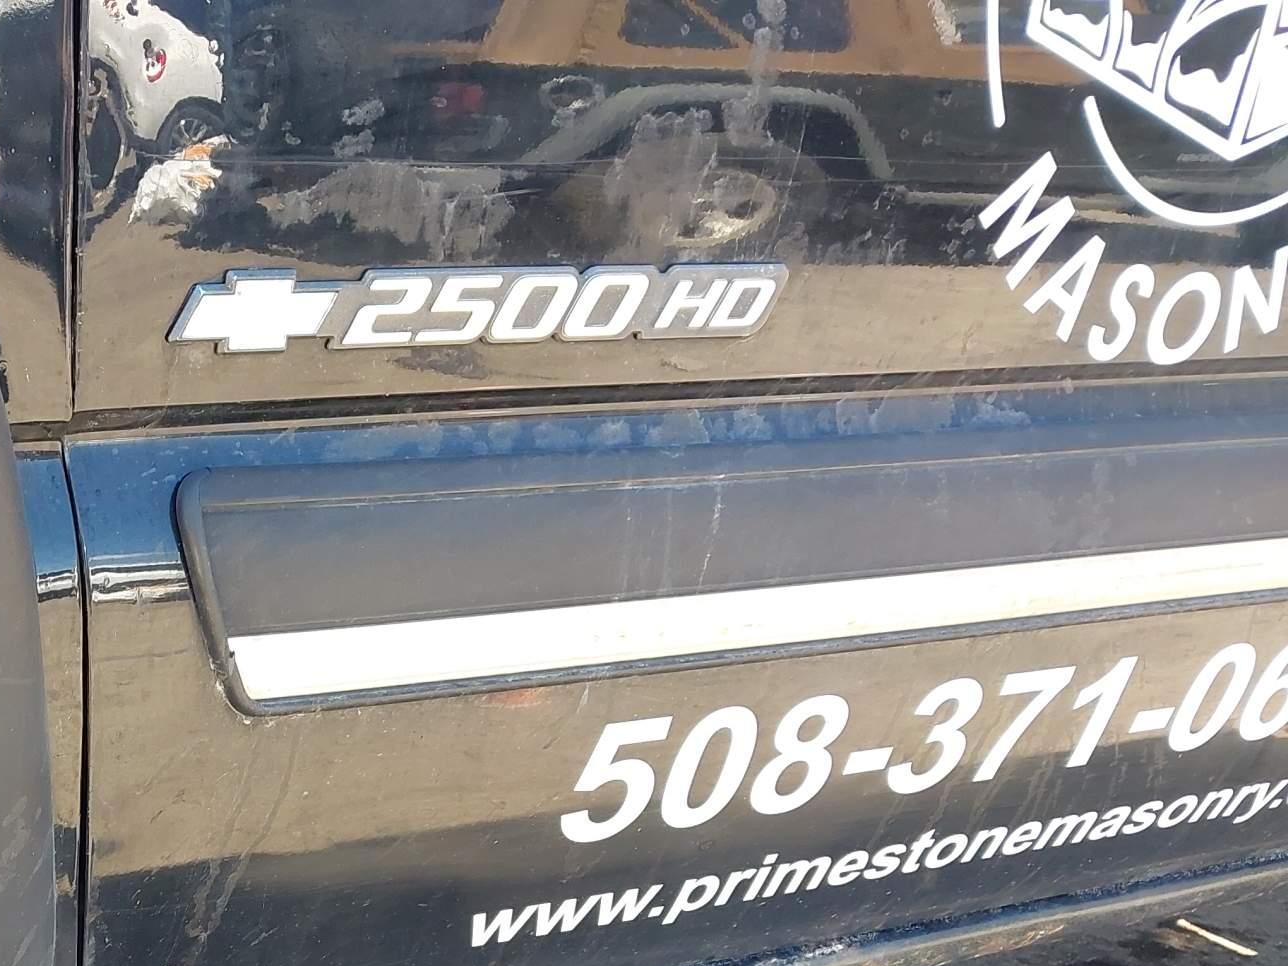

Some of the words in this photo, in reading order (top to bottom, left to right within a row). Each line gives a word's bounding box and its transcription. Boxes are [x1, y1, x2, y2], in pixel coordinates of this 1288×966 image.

[340, 272, 650, 346] 2500
[653, 276, 777, 330] HD
[977, 150, 1288, 365] MASON
[470, 778, 1288, 948] www.primestonemasonry.
